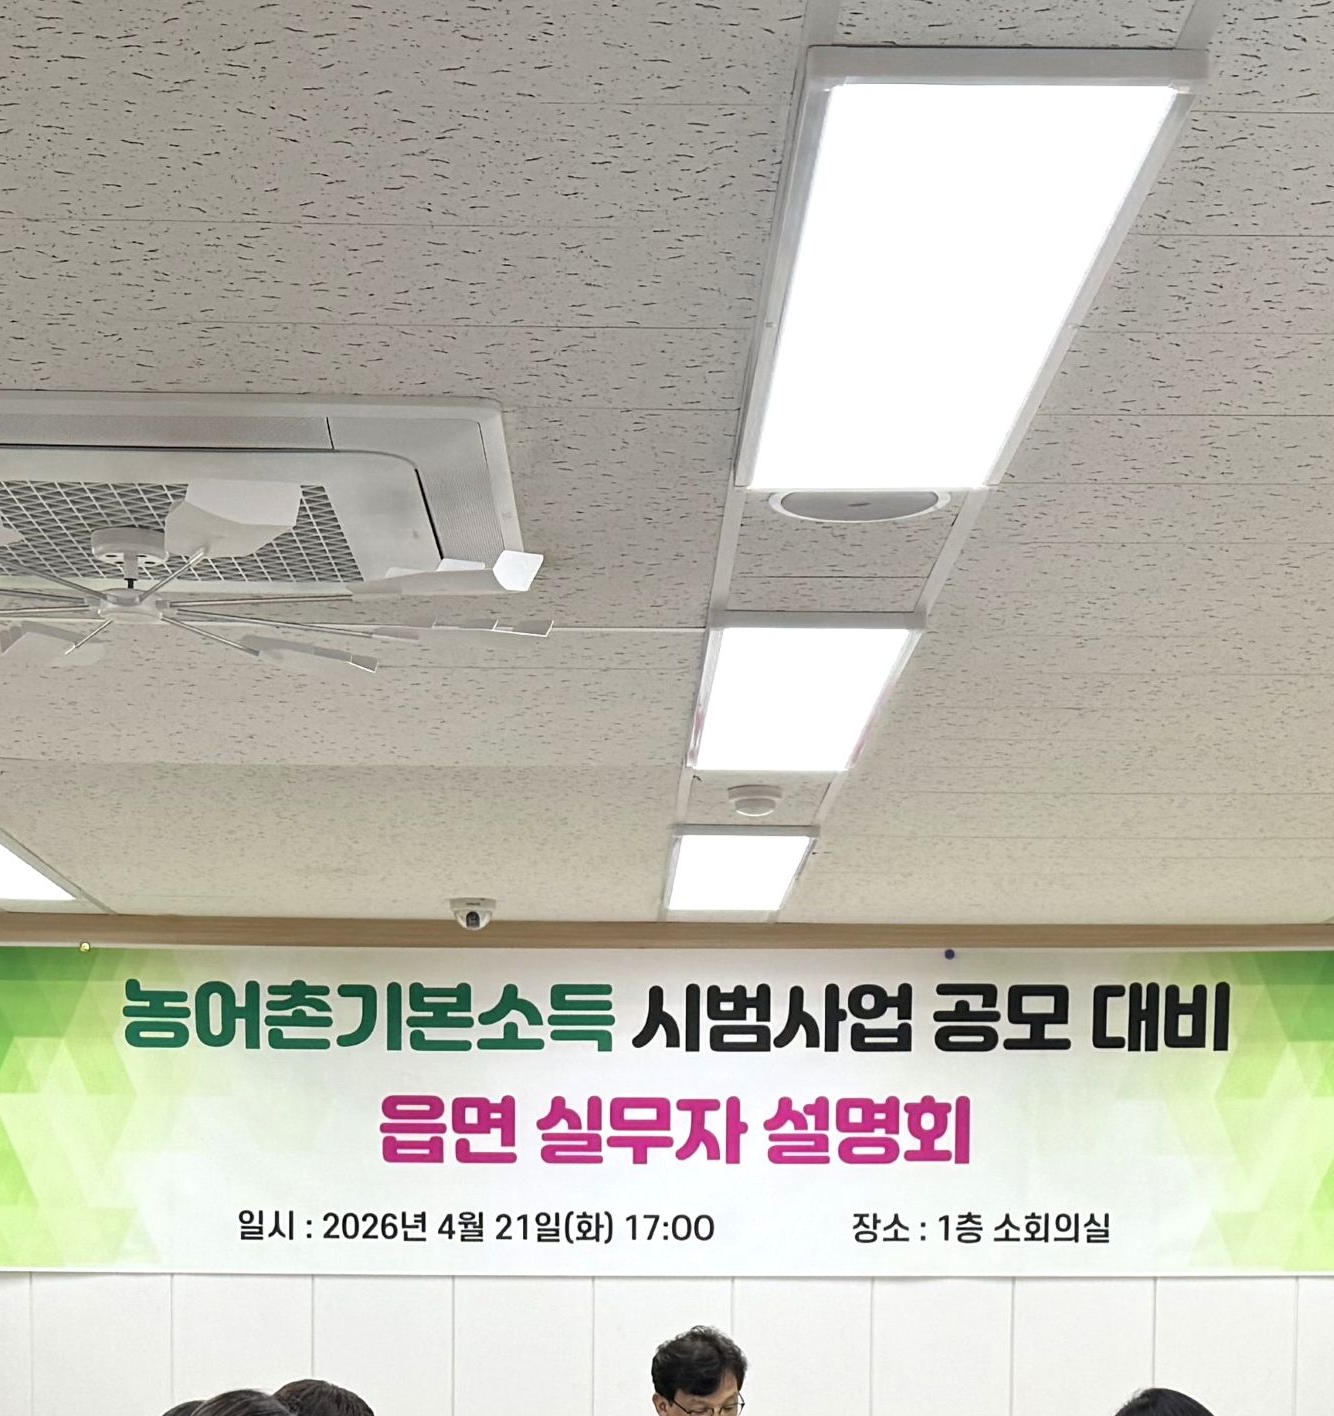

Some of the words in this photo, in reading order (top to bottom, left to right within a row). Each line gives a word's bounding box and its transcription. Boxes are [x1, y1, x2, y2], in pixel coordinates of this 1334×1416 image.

[121, 978, 616, 1052] 농어촌기본소득
[631, 982, 913, 1053] 시범사업
[932, 983, 1072, 1053] 공모
[1091, 981, 1231, 1053] 대비
[379, 1094, 518, 1164] 읍면
[536, 1095, 749, 1165] 실무자
[763, 1095, 971, 1165] 설명회
[238, 1209, 294, 1241] 일시
[322, 1211, 427, 1242] 2026년
[437, 1211, 484, 1243] 4월
[495, 1210, 613, 1244] 21일(화)
[625, 1214, 715, 1241] 17:00
[852, 1212, 910, 1244] 장소
[938, 1211, 983, 1244] 1층
[993, 1212, 1110, 1244] 소회의실
